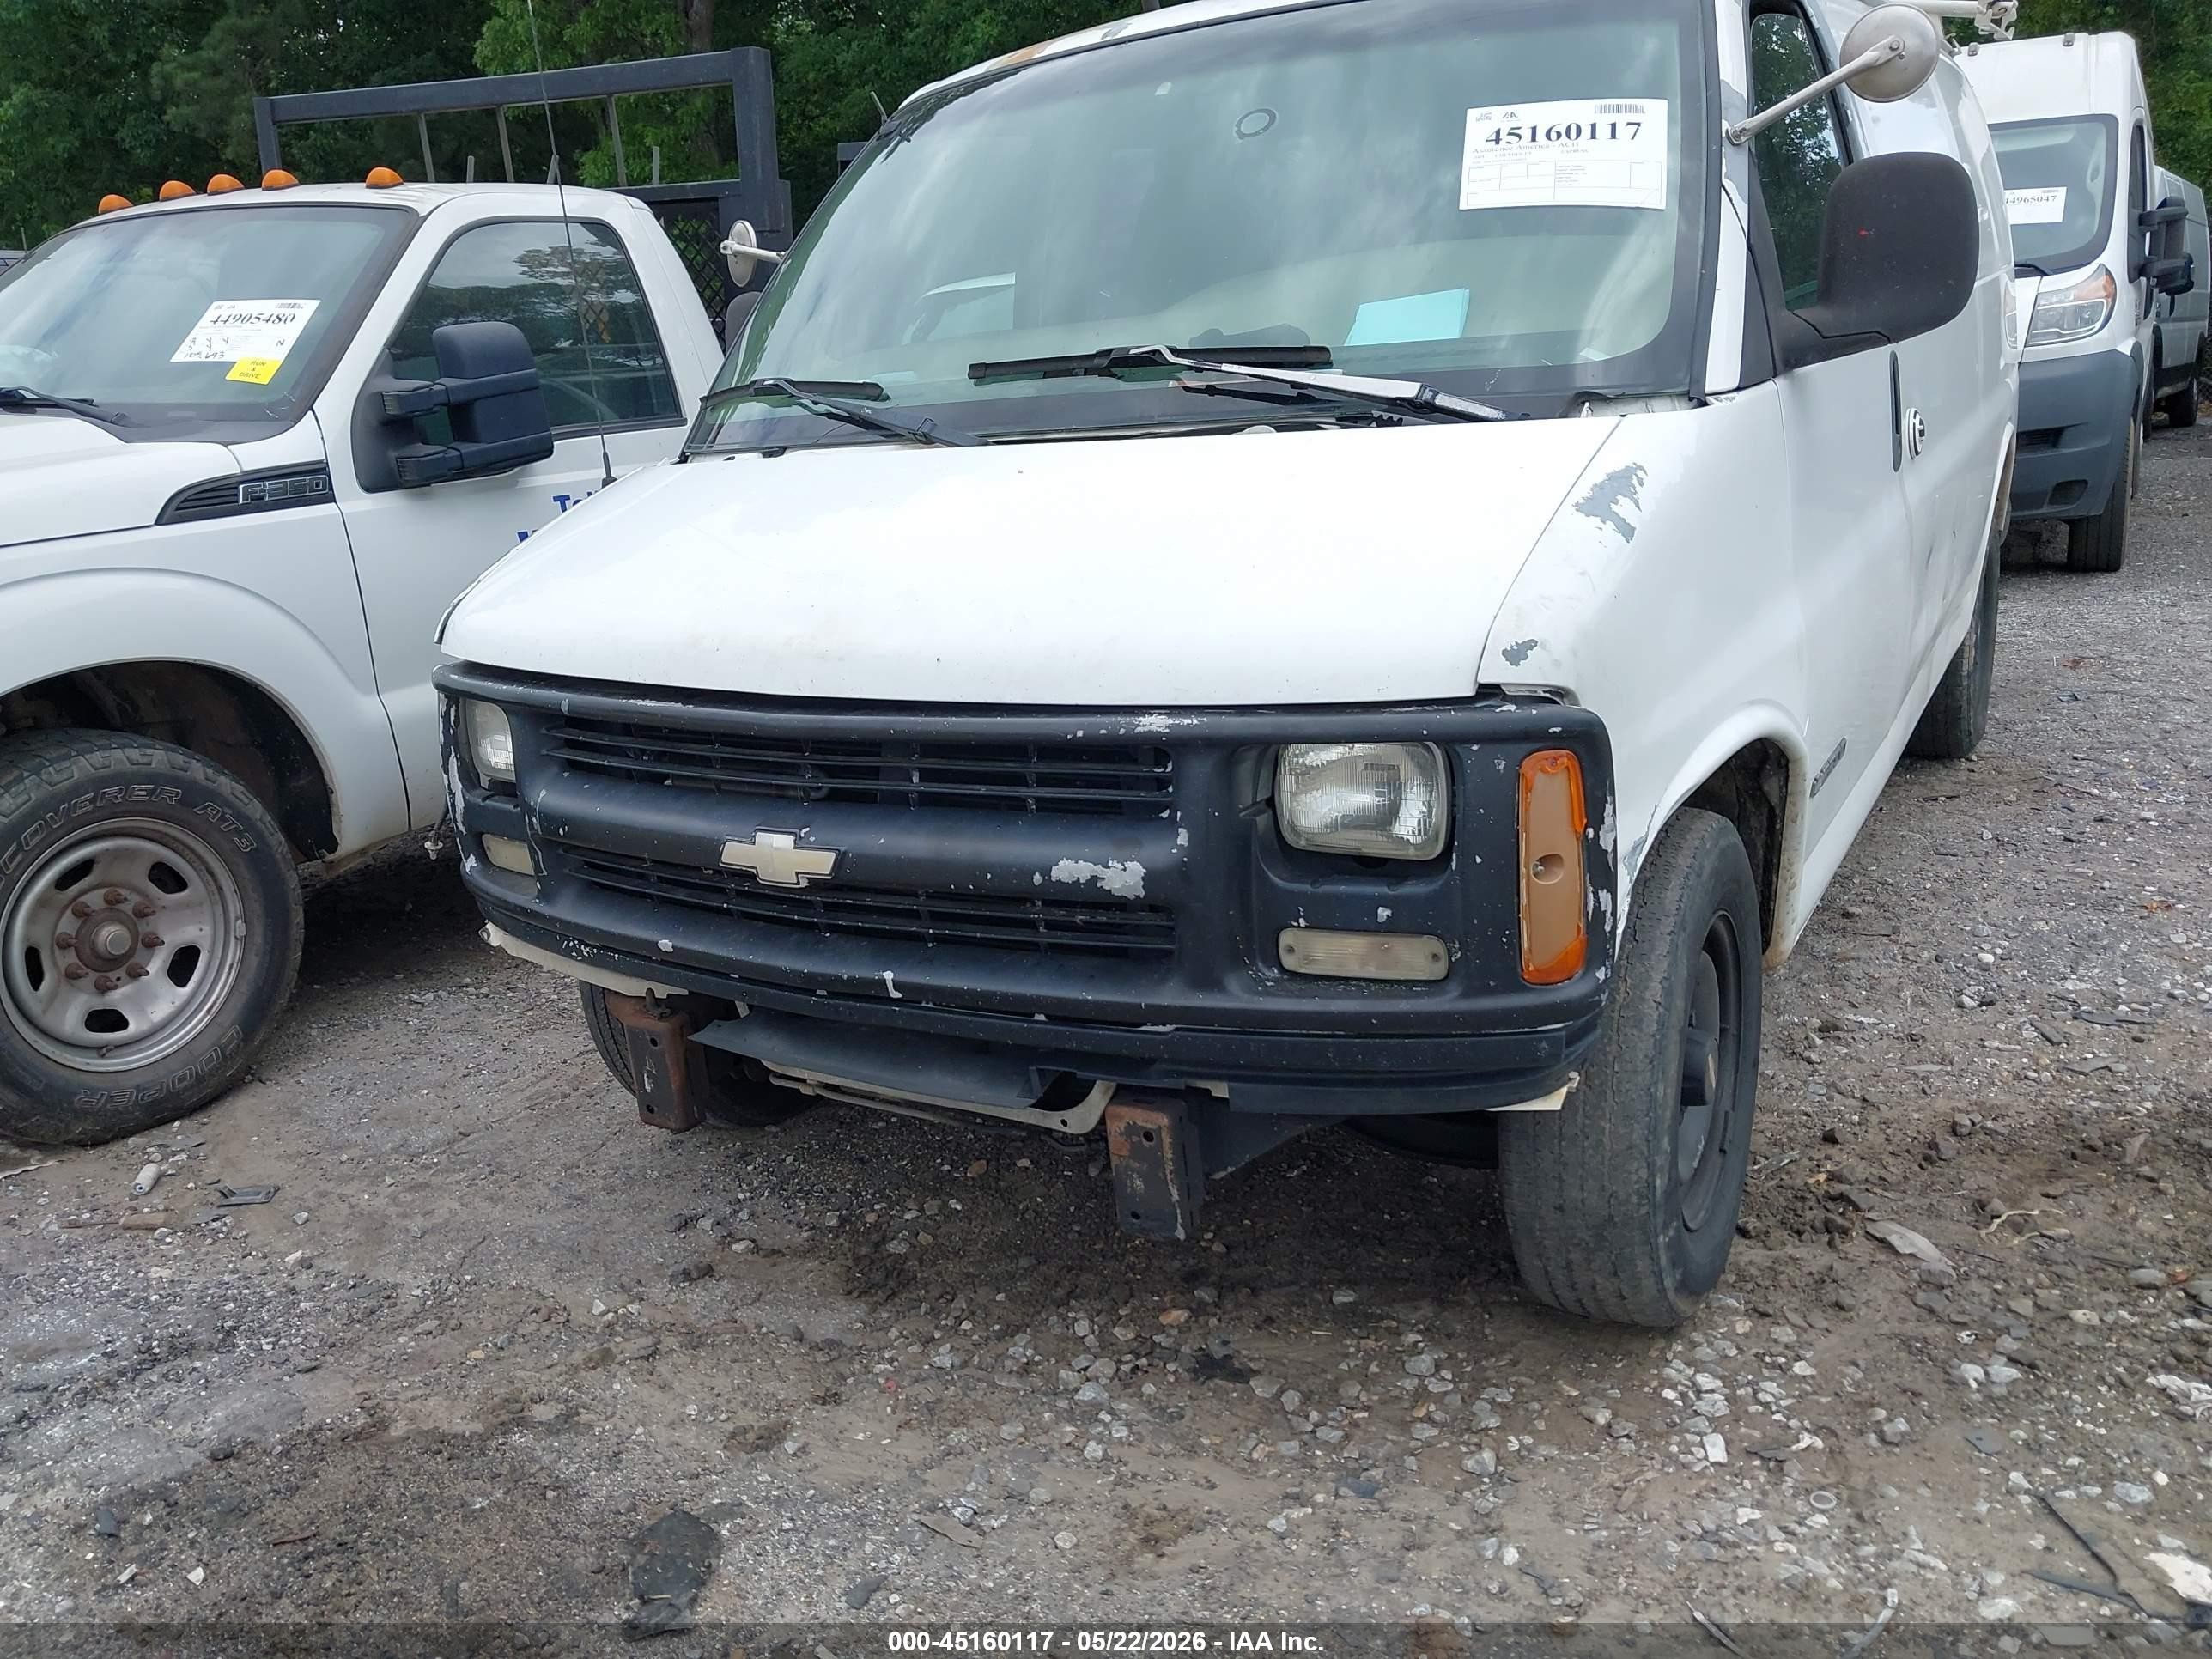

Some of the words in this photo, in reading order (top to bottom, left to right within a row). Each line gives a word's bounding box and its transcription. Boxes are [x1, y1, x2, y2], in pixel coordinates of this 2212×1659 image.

[1485, 121, 1643, 145] 45160117
[210, 313, 296, 325] 44905480
[239, 475, 329, 505] F-350
[0, 785, 182, 878] COVERER
